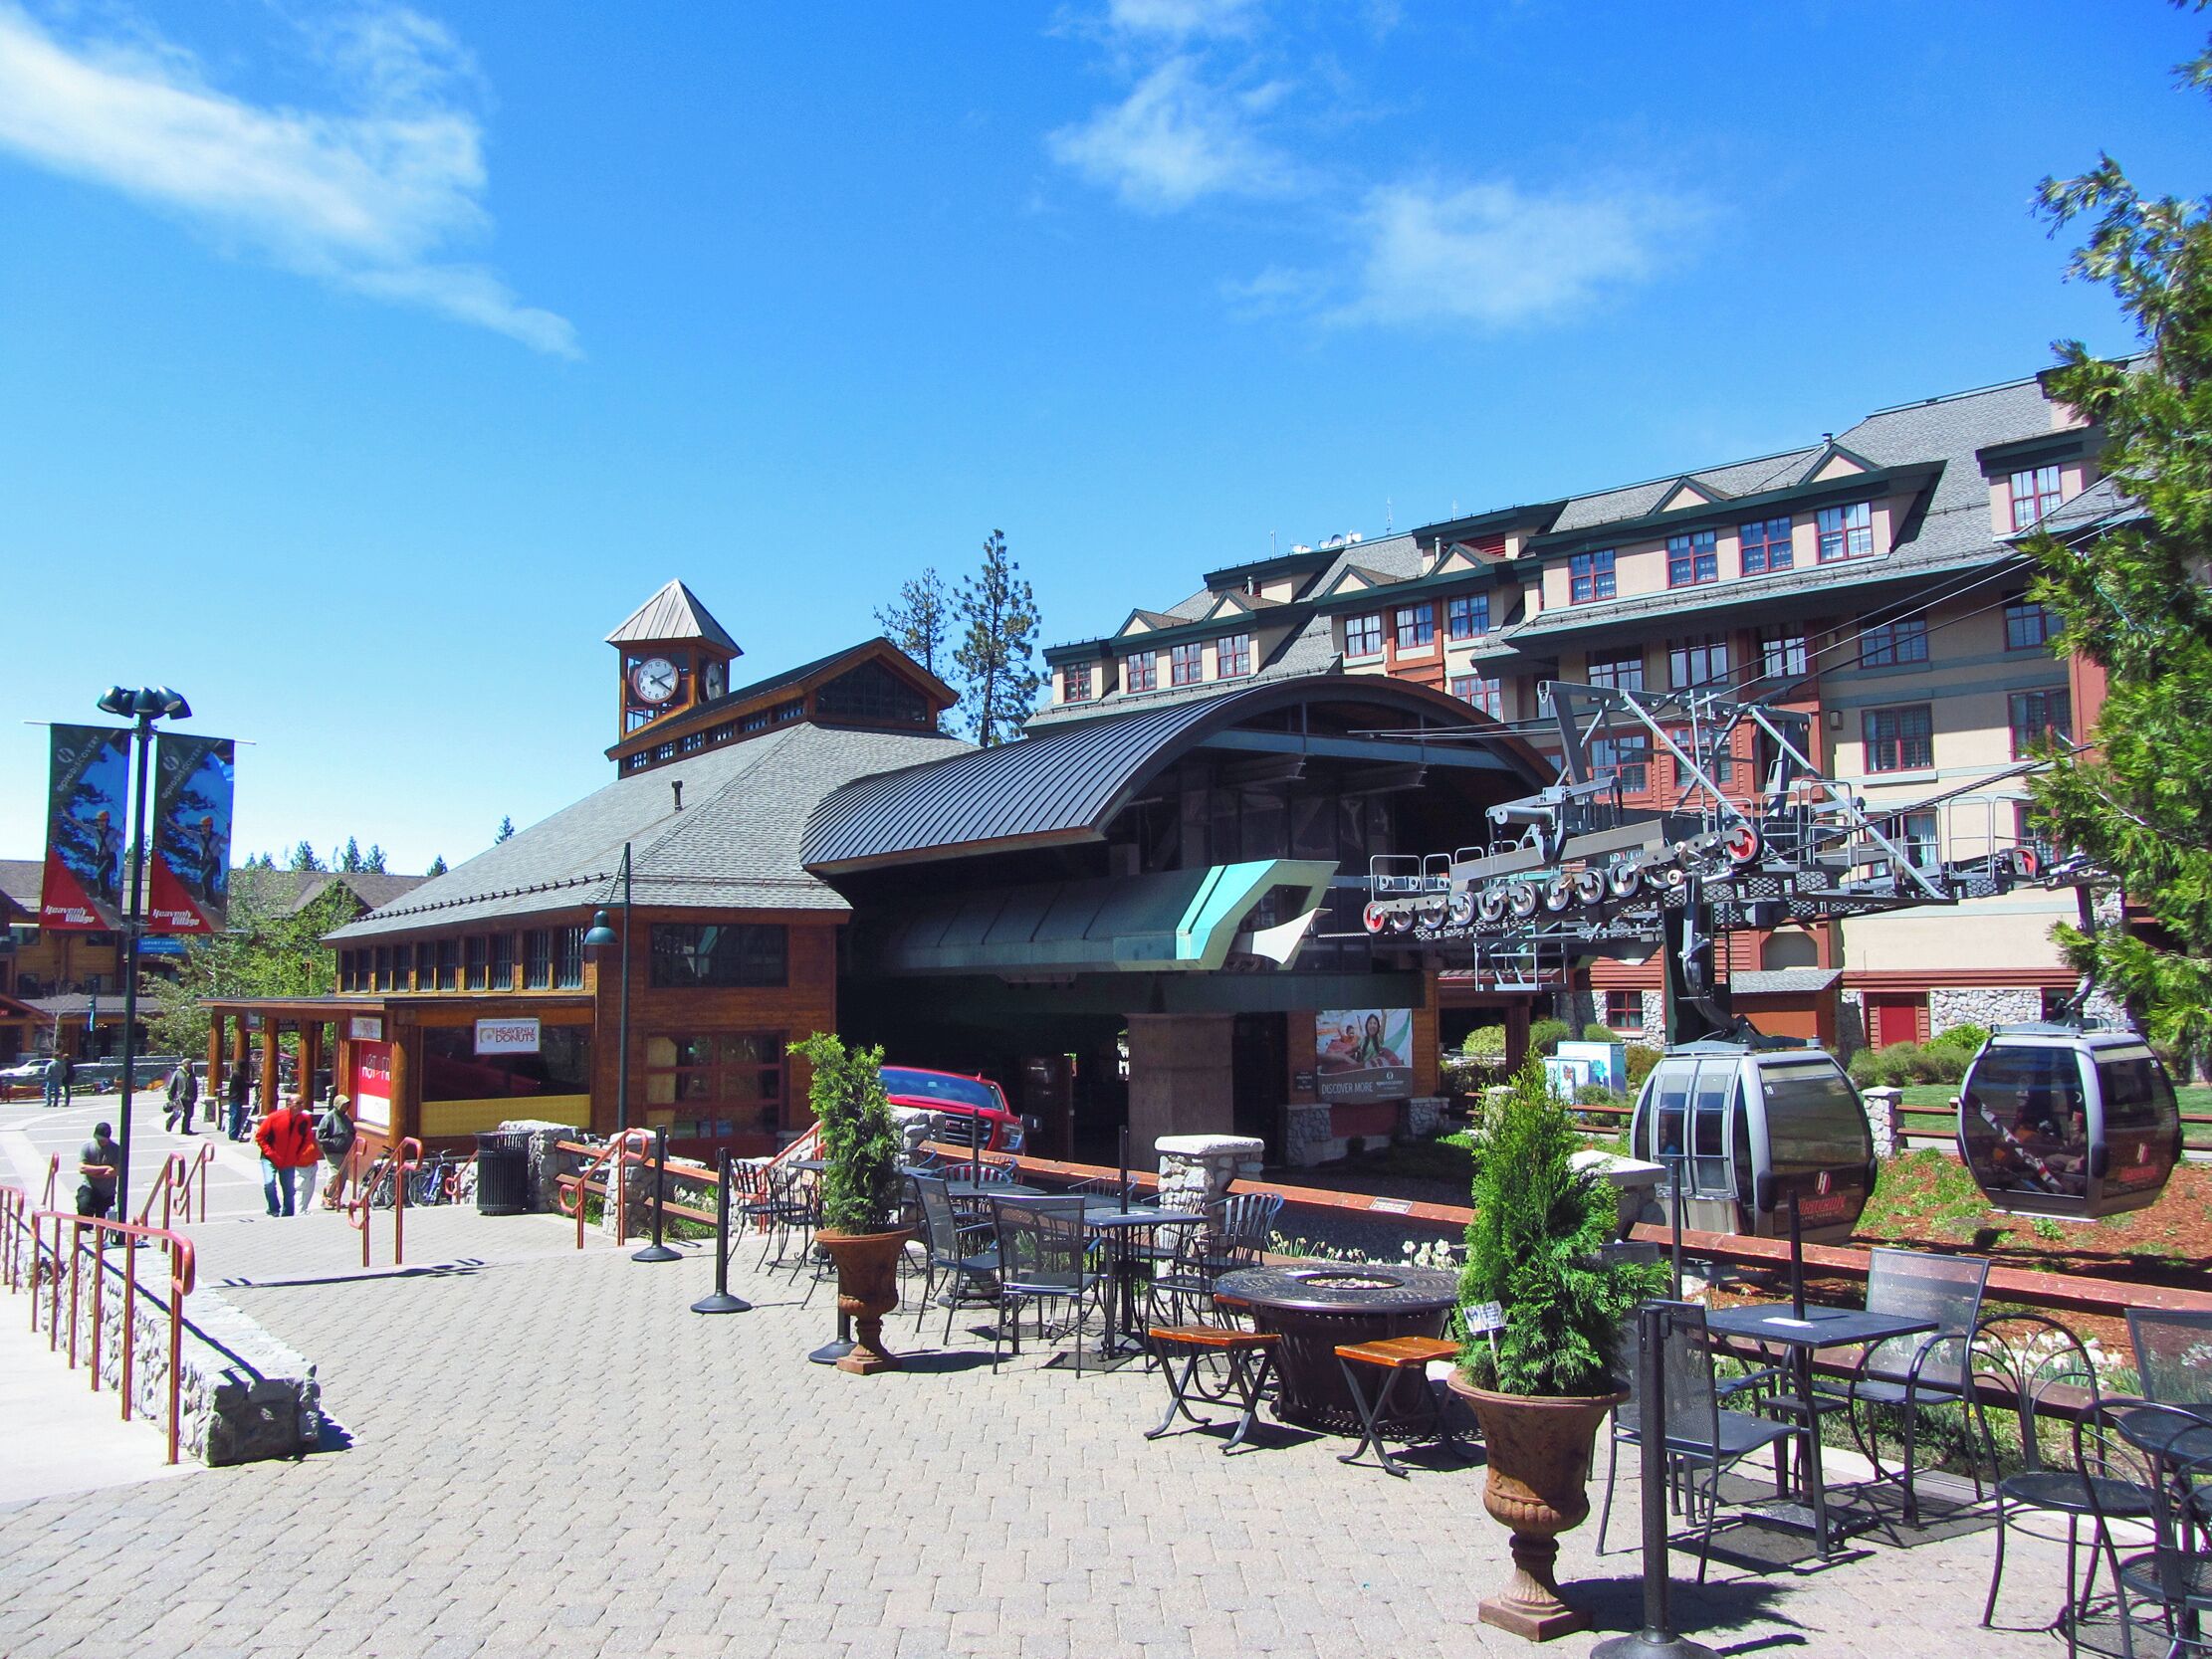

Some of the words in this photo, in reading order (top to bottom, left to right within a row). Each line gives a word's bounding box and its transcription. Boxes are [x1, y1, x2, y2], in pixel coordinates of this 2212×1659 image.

[45, 905, 88, 916] Heavenly
[152, 909, 192, 919] Heavenly
[65, 914, 95, 925] Village
[171, 917, 199, 927] Village
[496, 1033, 536, 1043] DONUTS
[1321, 1082, 1353, 1095] DISCOVER
[1354, 1081, 1374, 1093] MORE
